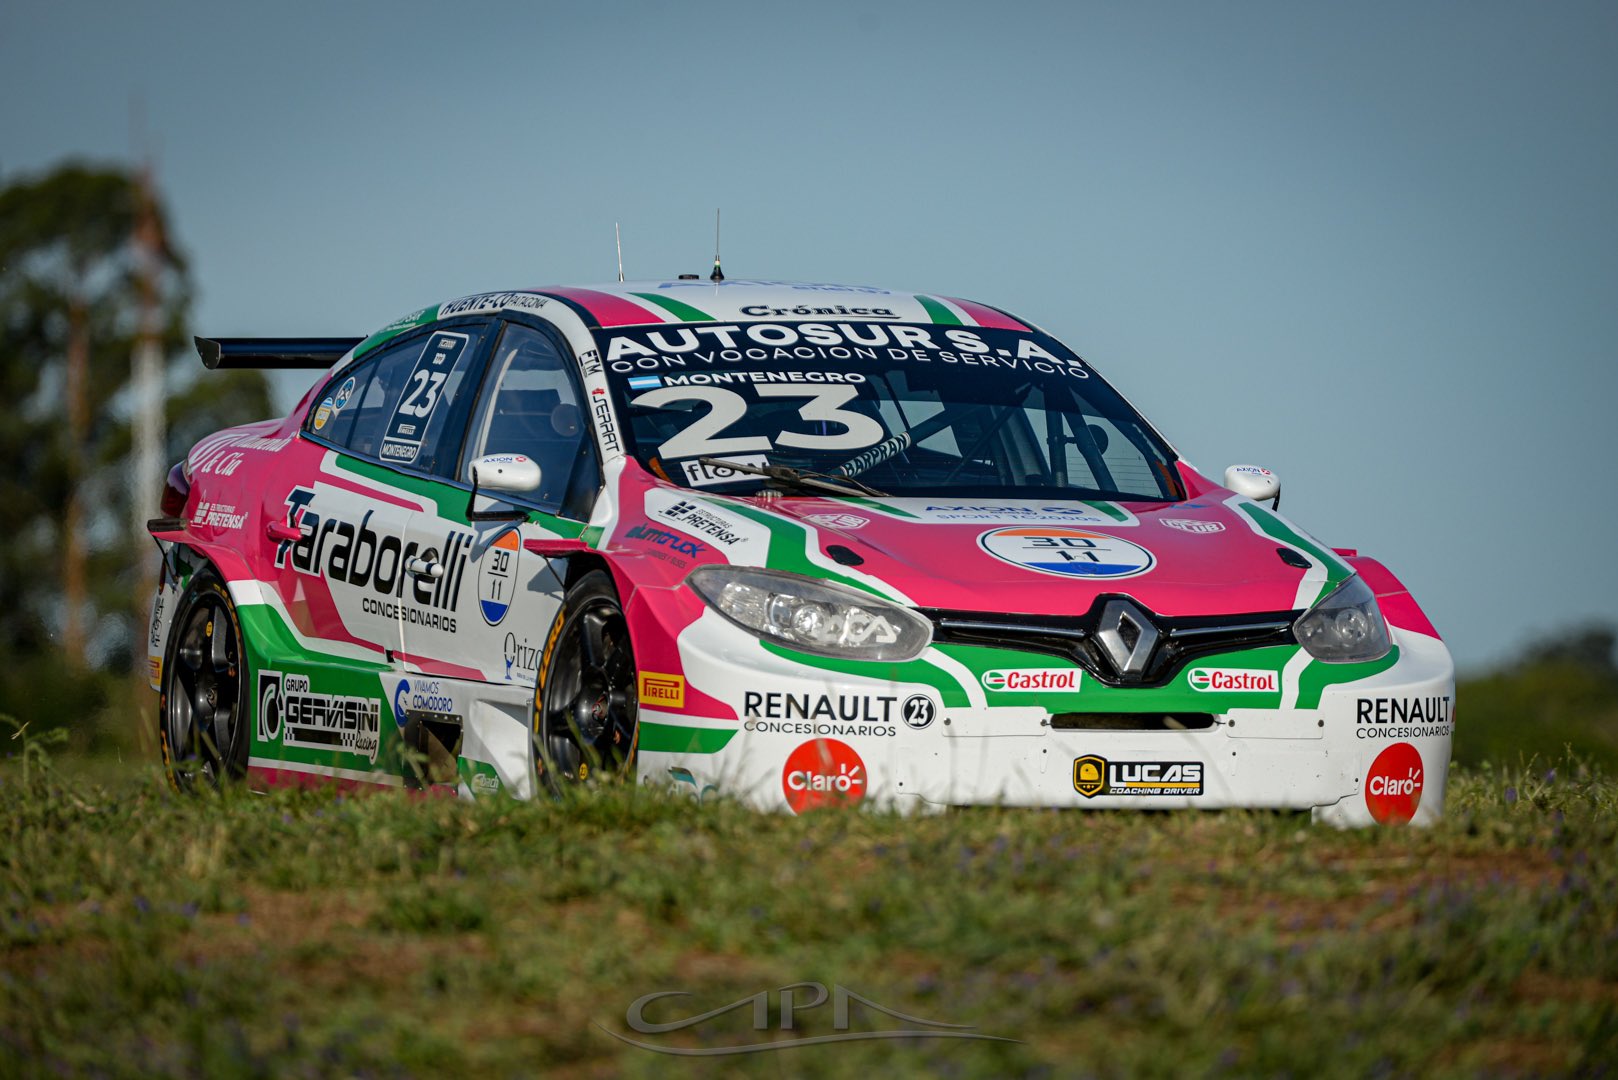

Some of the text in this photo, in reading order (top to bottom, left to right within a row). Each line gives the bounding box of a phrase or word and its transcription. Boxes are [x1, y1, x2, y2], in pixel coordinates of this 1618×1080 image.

[440, 292, 511, 315] HUENTE-CO
[738, 304, 896, 317] Crónica
[607, 323, 1083, 368] AUTOSUR S.A.
[610, 352, 684, 374] CON
[703, 345, 878, 364] VOCACION
[888, 348, 931, 364] DE
[937, 351, 1090, 380] SERVICIO
[663, 371, 867, 387] MONTENEGRO
[398, 369, 447, 418] 23
[593, 395, 620, 452] SERRAT
[630, 384, 885, 460] 23
[381, 442, 418, 459] MONTENEGRO
[842, 433, 910, 478] BARPRAN
[695, 509, 733, 529] ESTRUCTURAS
[925, 505, 1034, 513] AXION
[205, 511, 245, 530] PRETENSA
[682, 514, 740, 546] PRETENSA
[277, 488, 474, 612] Taraborelli
[1023, 537, 1097, 548] 30
[491, 550, 510, 573] 30
[1056, 550, 1100, 562] 11
[491, 578, 502, 601] 11
[362, 597, 457, 634] CONCESIONARIOS
[286, 678, 308, 693] GRUPO
[414, 680, 439, 694] VIVAMOS
[643, 678, 680, 700] PIRELLI
[1006, 671, 1076, 689] Castrol
[1211, 671, 1275, 690] Castrol
[285, 696, 379, 732] GERVASINI
[412, 695, 453, 713] COMODORO
[744, 691, 897, 722] RENAULT
[909, 699, 930, 725] 23
[1356, 697, 1450, 724] RENAULT
[744, 721, 896, 737] CONCESIONARIOS
[1356, 725, 1450, 739] CONCESIONARIOS
[354, 731, 377, 760] Racing
[788, 770, 851, 792] Claro
[1109, 765, 1201, 787] LUCAS
[1369, 775, 1414, 796] Claro
